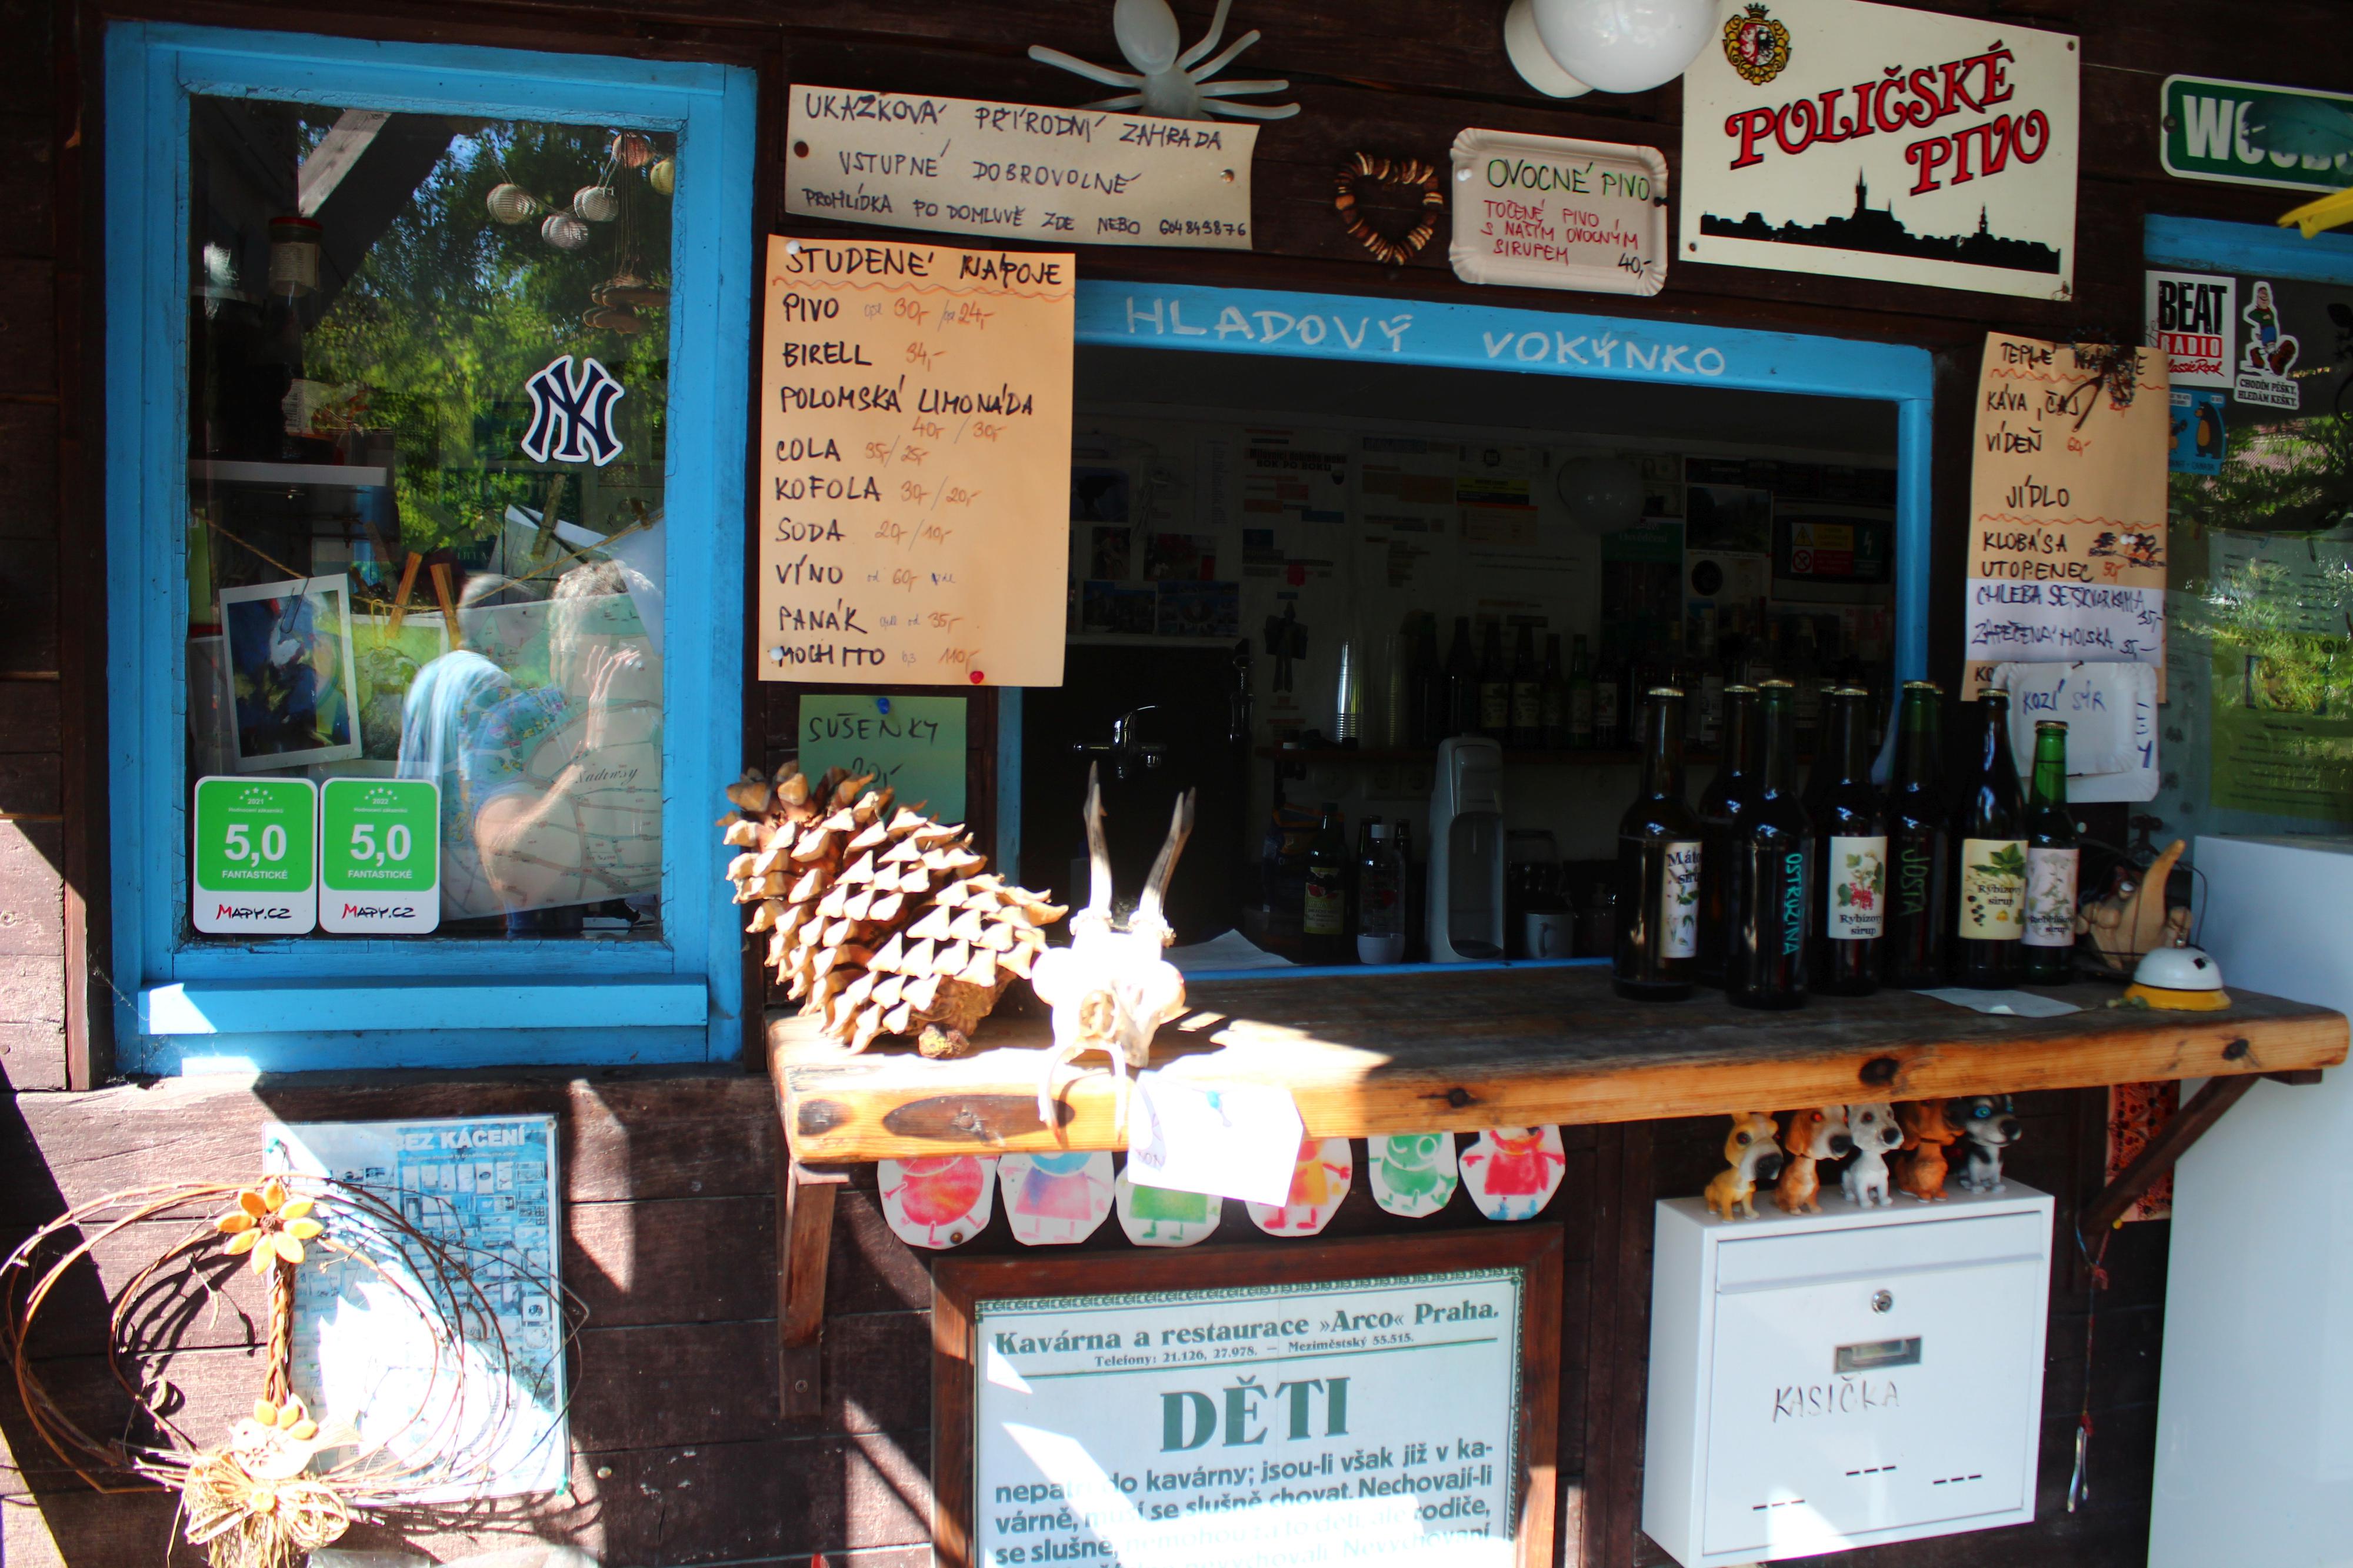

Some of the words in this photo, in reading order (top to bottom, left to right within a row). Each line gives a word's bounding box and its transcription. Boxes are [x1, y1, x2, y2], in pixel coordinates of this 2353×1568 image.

[1725, 39, 2015, 171] POLIČSKÉ
[1120, 123, 1222, 151] ZAHRADA
[1905, 108, 2050, 196] PIVO
[1488, 158, 1594, 193] OVOCNÉ
[1602, 171, 1651, 201] PIVO
[914, 199, 938, 217] PO
[1042, 212, 1074, 231] ZDE
[1098, 217, 1141, 235] NEBO
[1562, 208, 1599, 227] PIVO
[1494, 238, 1569, 266] SIRUPEM
[782, 293, 839, 321] PIVO
[2158, 279, 2228, 335] BEAT
[1125, 295, 1414, 353] HLADOVÝ
[1482, 328, 1726, 377] VOKÝNKO
[2160, 332, 2221, 358] RADIO
[782, 341, 872, 366] BIRELL
[918, 383, 1033, 416] LIMONÁDA
[776, 439, 841, 462] COLA
[775, 475, 881, 502] KOFOLA
[2006, 474, 2069, 508] JÍDLO
[775, 517, 845, 542] SODA
[1983, 528, 2067, 554] KLOBÁSA
[775, 554, 844, 585] VÍNO
[1982, 561, 2094, 583] UTOPENEC
[224, 823, 287, 868] 5,0
[350, 823, 411, 868] 5,0
[222, 868, 288, 879] FANTASTICKÉ
[348, 868, 413, 879] FANTASTICKÉ
[1988, 897, 2015, 908] sirup
[1851, 926, 1877, 936] sirup
[995, 1330, 1121, 1356] Kavárna
[1134, 1332, 1151, 1347] a
[1161, 1315, 1309, 1345] restaurace
[1414, 1300, 1499, 1326] Praha.
[1095, 1353, 1157, 1368] Telefony:
[1288, 1335, 1367, 1355] Meziměstský
[1159, 1375, 1351, 1453] DĚTI
[1772, 1376, 1901, 1423] KASIČKA
[1146, 1466, 1254, 1493] kavárny;
[1261, 1453, 1334, 1484] jsou-li
[1341, 1447, 1394, 1471] však
[1403, 1443, 1428, 1468] již
[1436, 1446, 1449, 1463] v
[1458, 1438, 1494, 1460] ka-
[995, 1507, 1079, 1534] várně,
[1151, 1503, 1179, 1520] se
[1358, 1464, 1493, 1499] Nechovají-li
[995, 1545, 1025, 1566] se
